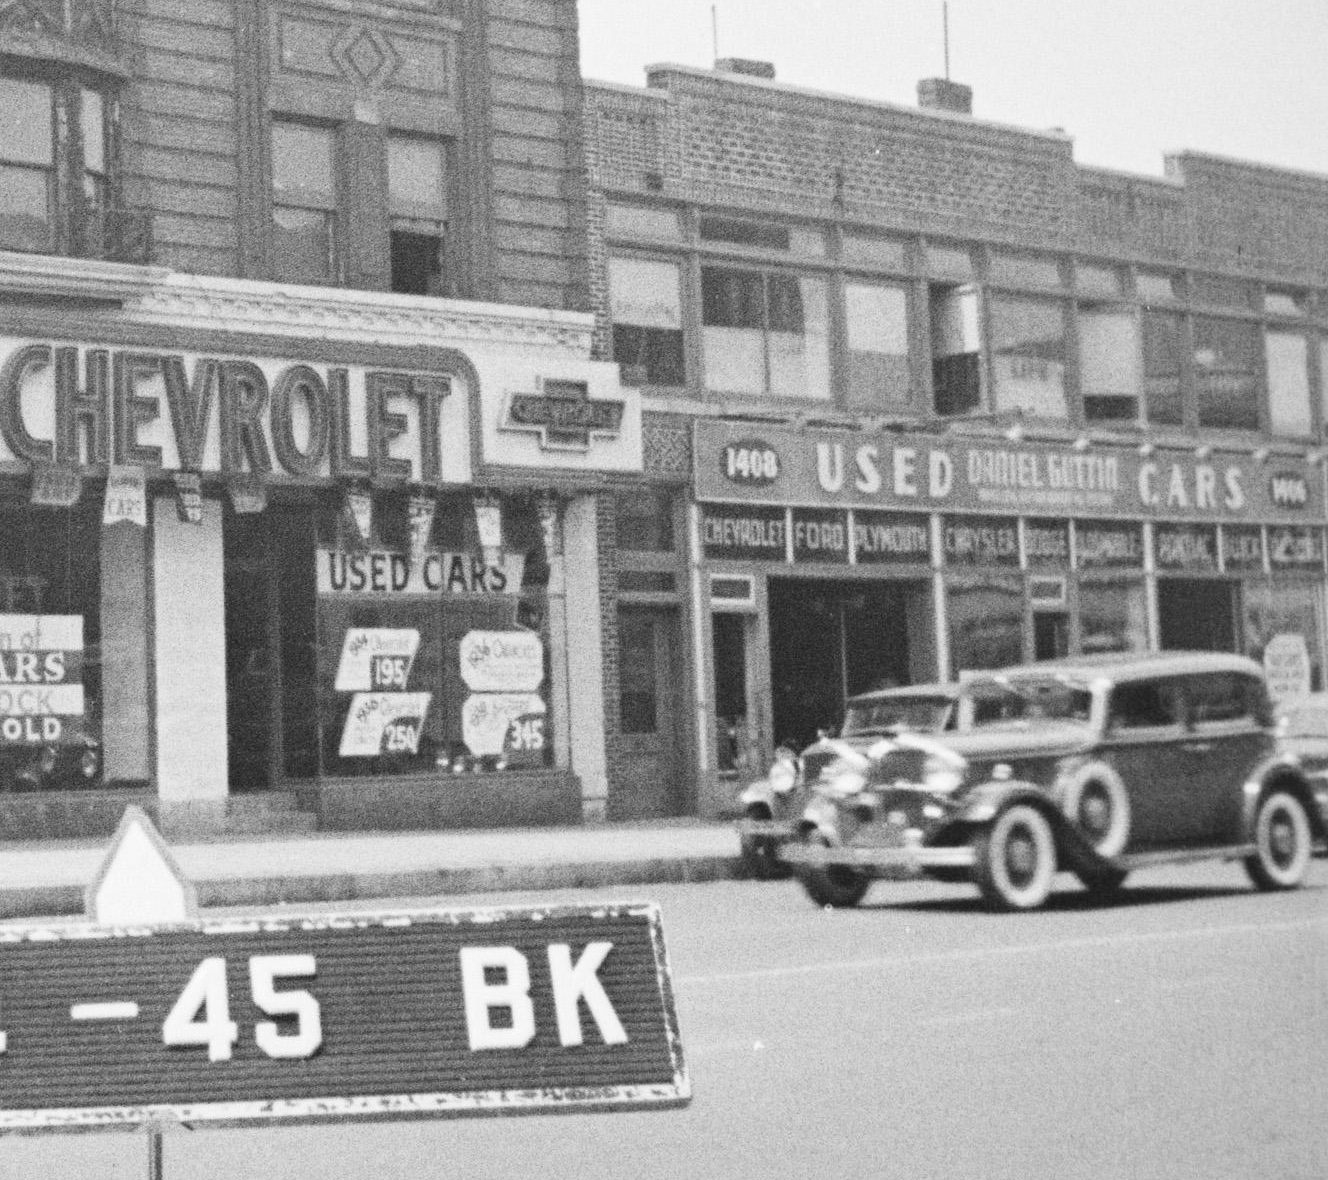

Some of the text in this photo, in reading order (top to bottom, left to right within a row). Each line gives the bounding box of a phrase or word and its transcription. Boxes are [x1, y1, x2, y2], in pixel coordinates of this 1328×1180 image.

[817, 442, 1245, 510] USED CARS
[705, 518, 784, 547] CHEVROLET
[796, 522, 844, 550] FORD
[329, 552, 411, 591] USED
[375, 658, 405, 686] 195
[458, 941, 629, 1051] BK
